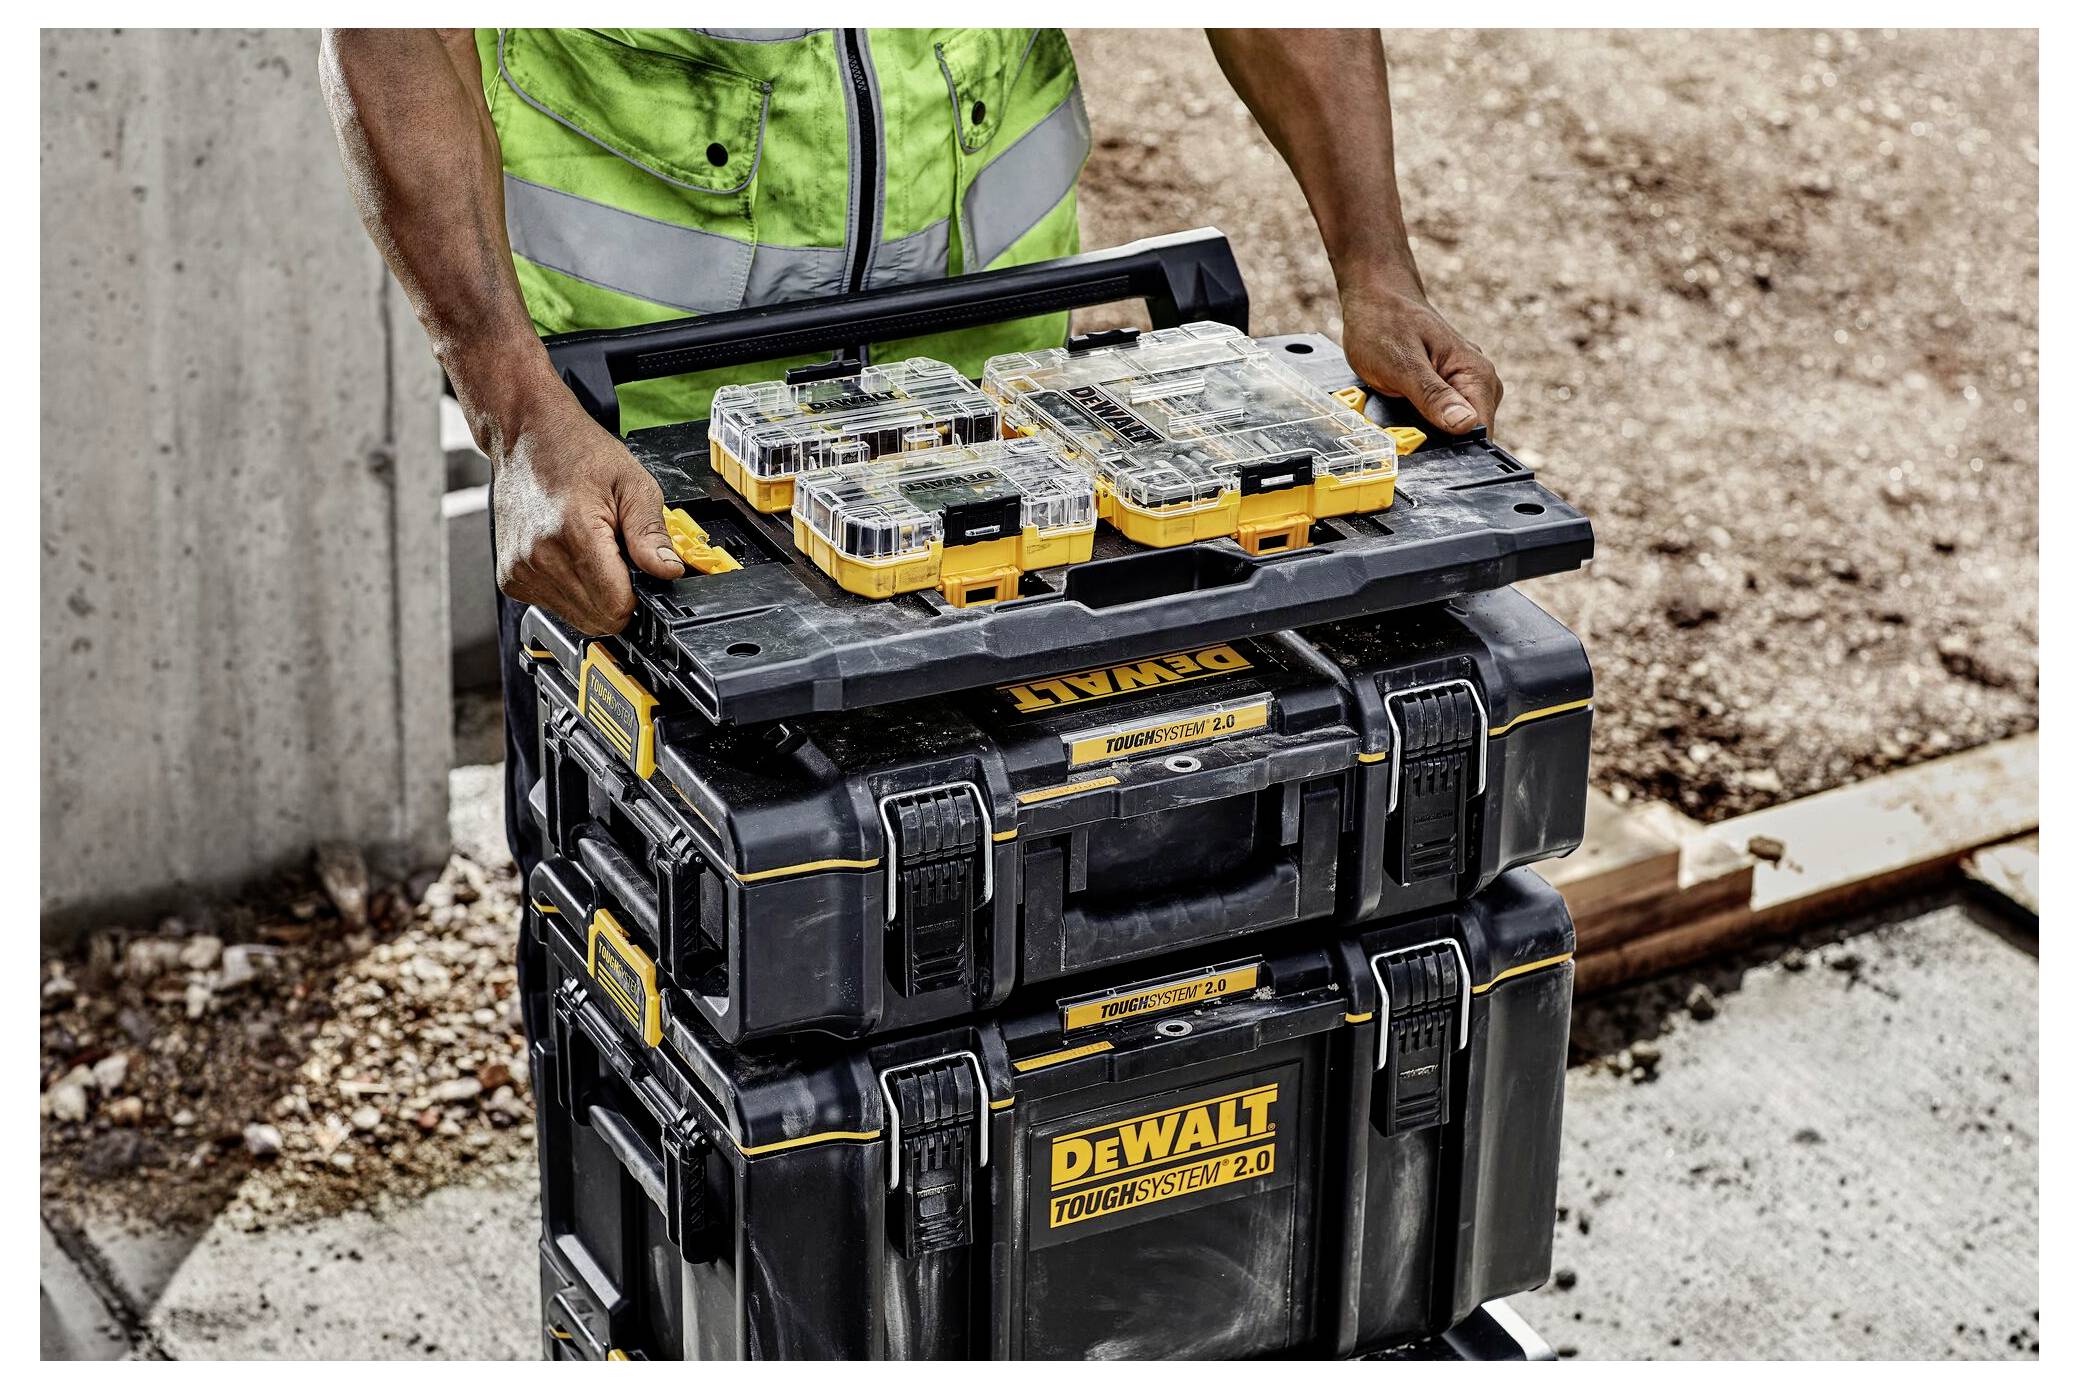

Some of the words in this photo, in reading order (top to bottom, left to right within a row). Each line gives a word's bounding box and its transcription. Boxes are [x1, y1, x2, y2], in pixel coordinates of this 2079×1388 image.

[1066, 386, 1163, 444] DEWALT
[905, 471, 996, 492] DEWALT
[1007, 646, 1250, 711] DEWALT
[591, 673, 633, 728] TOUGHSYSTEM
[1212, 714, 1235, 732] 2.0
[1205, 978, 1227, 995] 2.0
[1051, 1089, 1277, 1186] DEWALT
[1233, 1150, 1270, 1177] 2.0
